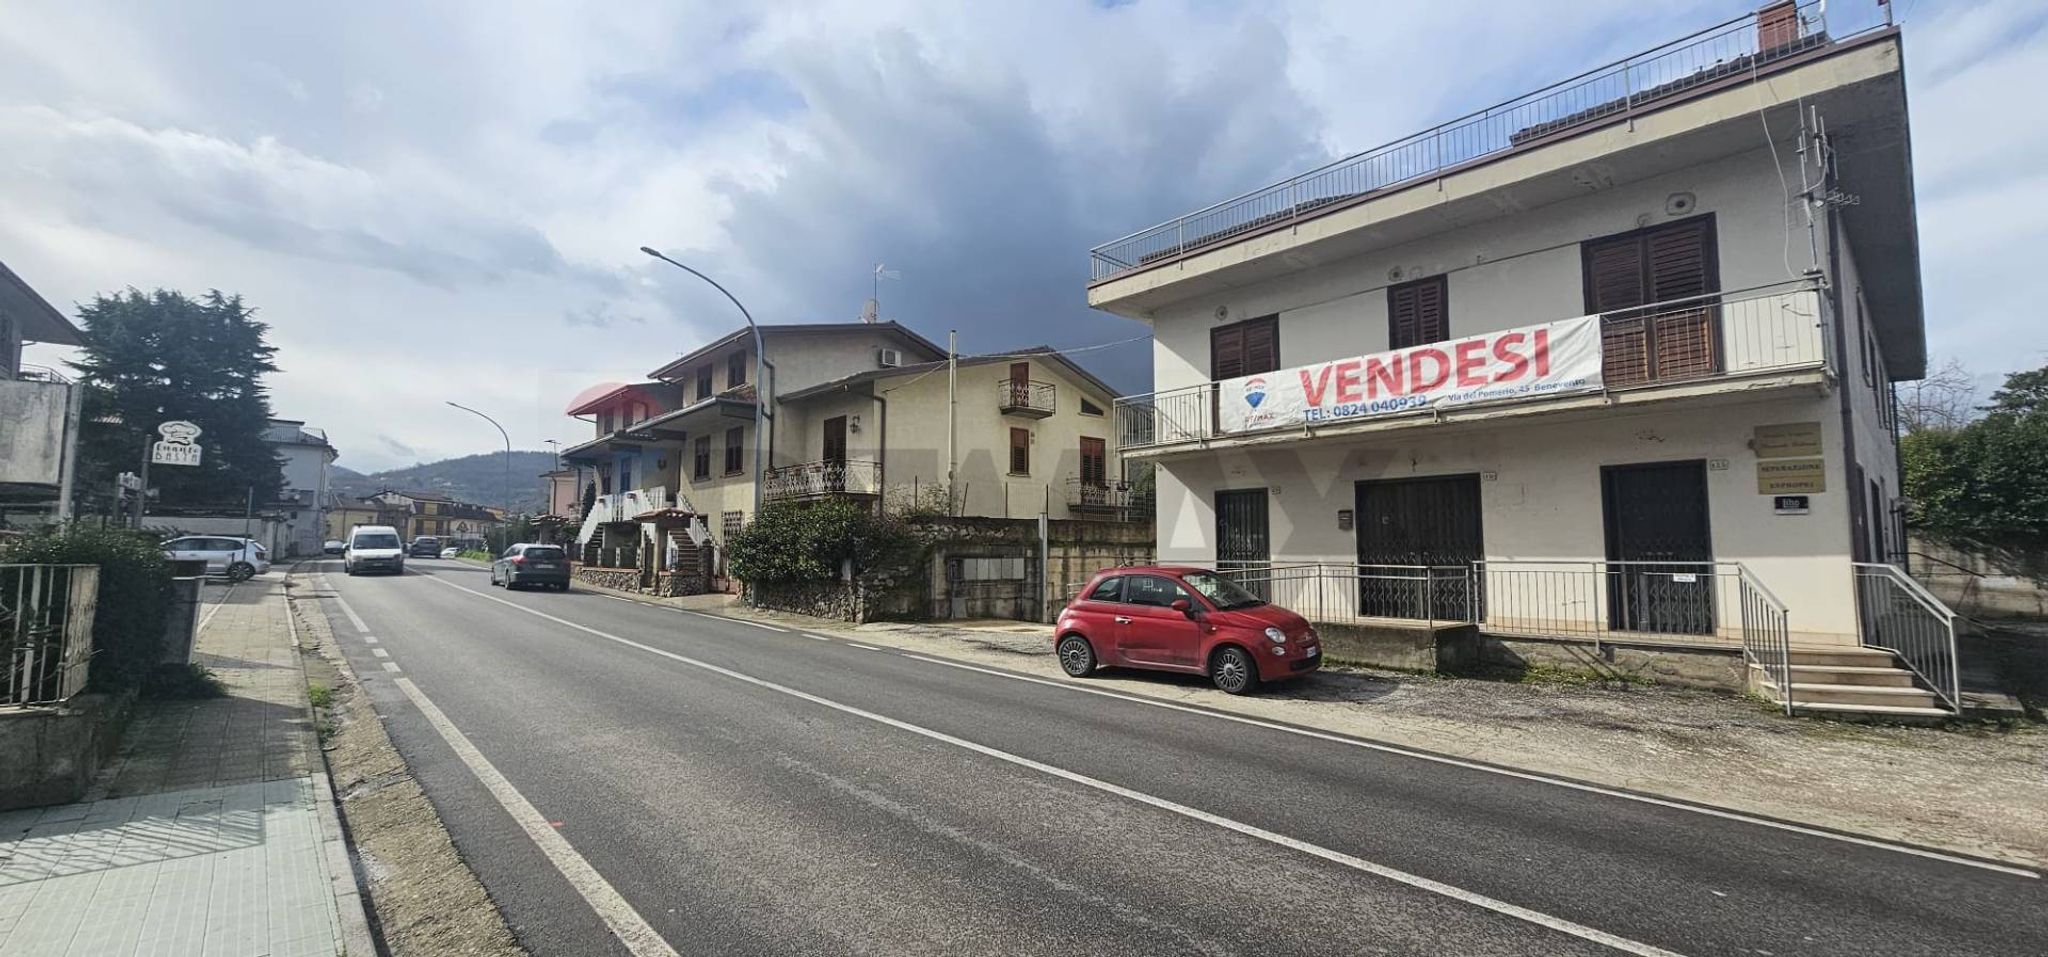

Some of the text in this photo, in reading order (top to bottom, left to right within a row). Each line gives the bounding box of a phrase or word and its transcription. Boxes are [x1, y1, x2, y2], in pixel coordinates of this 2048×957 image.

[1299, 329, 1550, 407] VENDESI
[1303, 395, 1428, 422] TEL: 0824 040939
